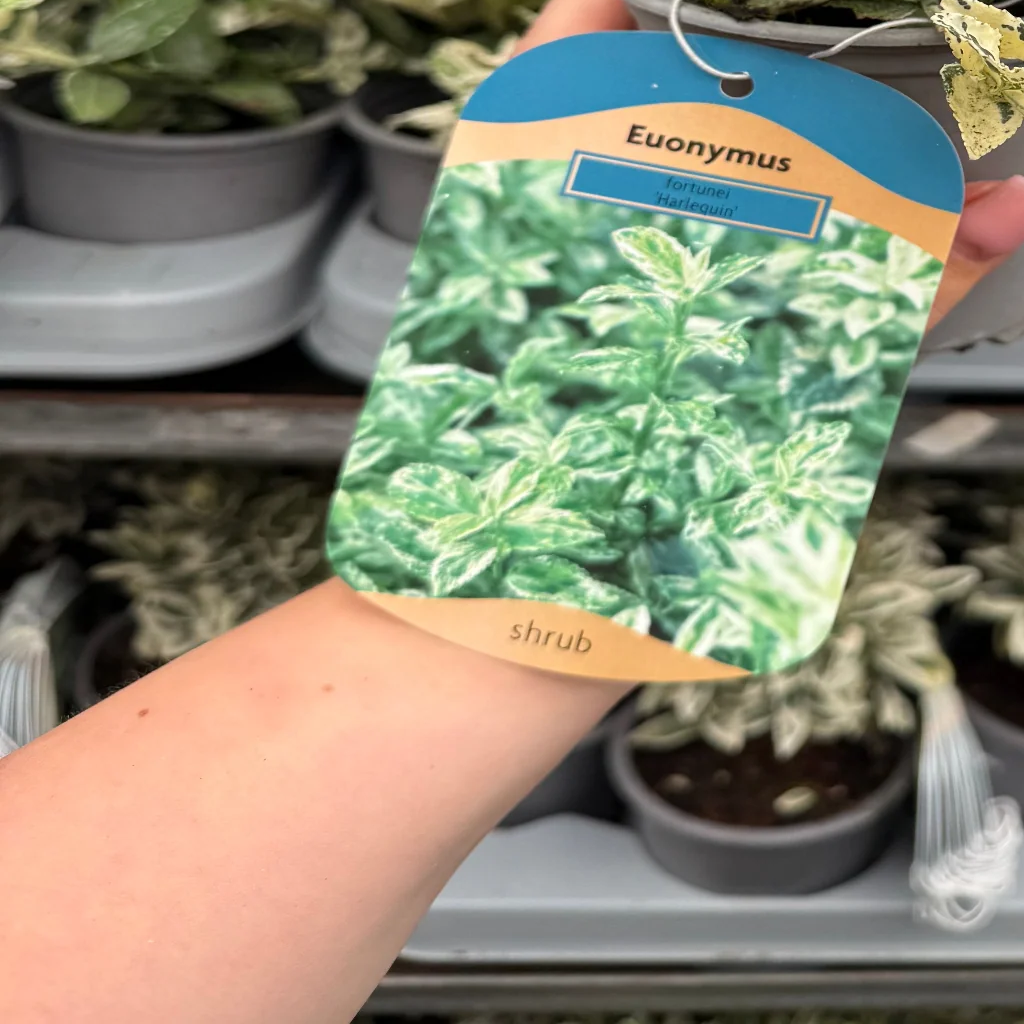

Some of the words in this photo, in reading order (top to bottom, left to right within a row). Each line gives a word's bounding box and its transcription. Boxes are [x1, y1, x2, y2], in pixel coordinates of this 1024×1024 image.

[626, 123, 792, 173] Euonymus
[666, 175, 731, 200] fortunei
[656, 191, 738, 217] 'Harlequin'
[509, 619, 593, 654] shrub
